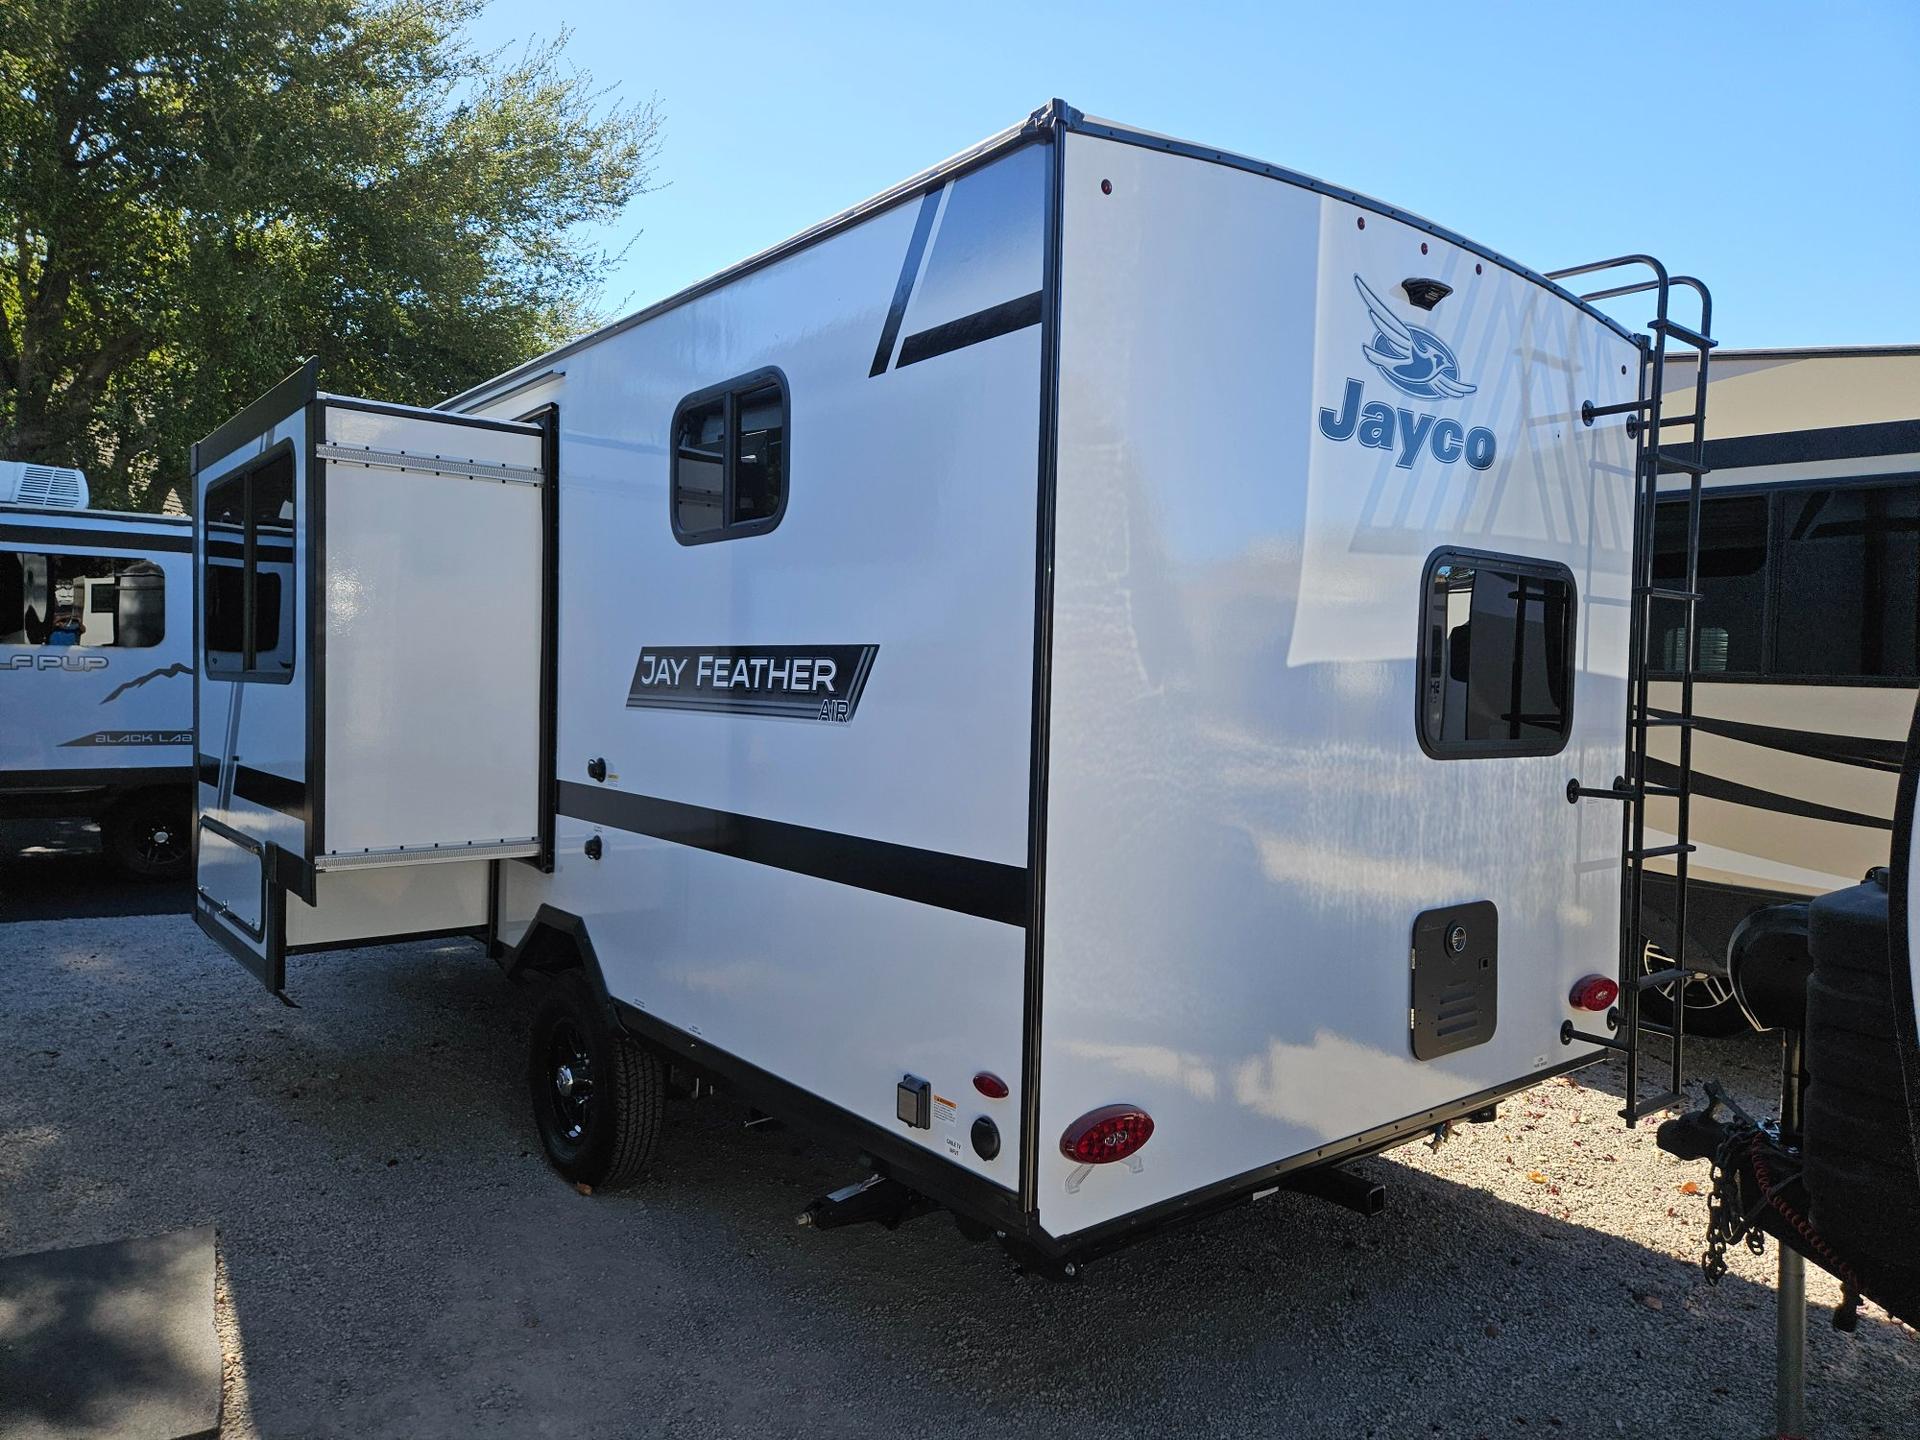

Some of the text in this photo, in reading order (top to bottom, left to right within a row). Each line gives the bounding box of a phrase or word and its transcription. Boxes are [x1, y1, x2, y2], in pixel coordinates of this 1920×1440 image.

[1319, 377, 1497, 471] Jayco
[37, 655, 109, 672] PUP
[641, 656, 836, 692] JAY FEATHER
[816, 699, 849, 723] AIR
[95, 734, 193, 743] BLACK LAB
